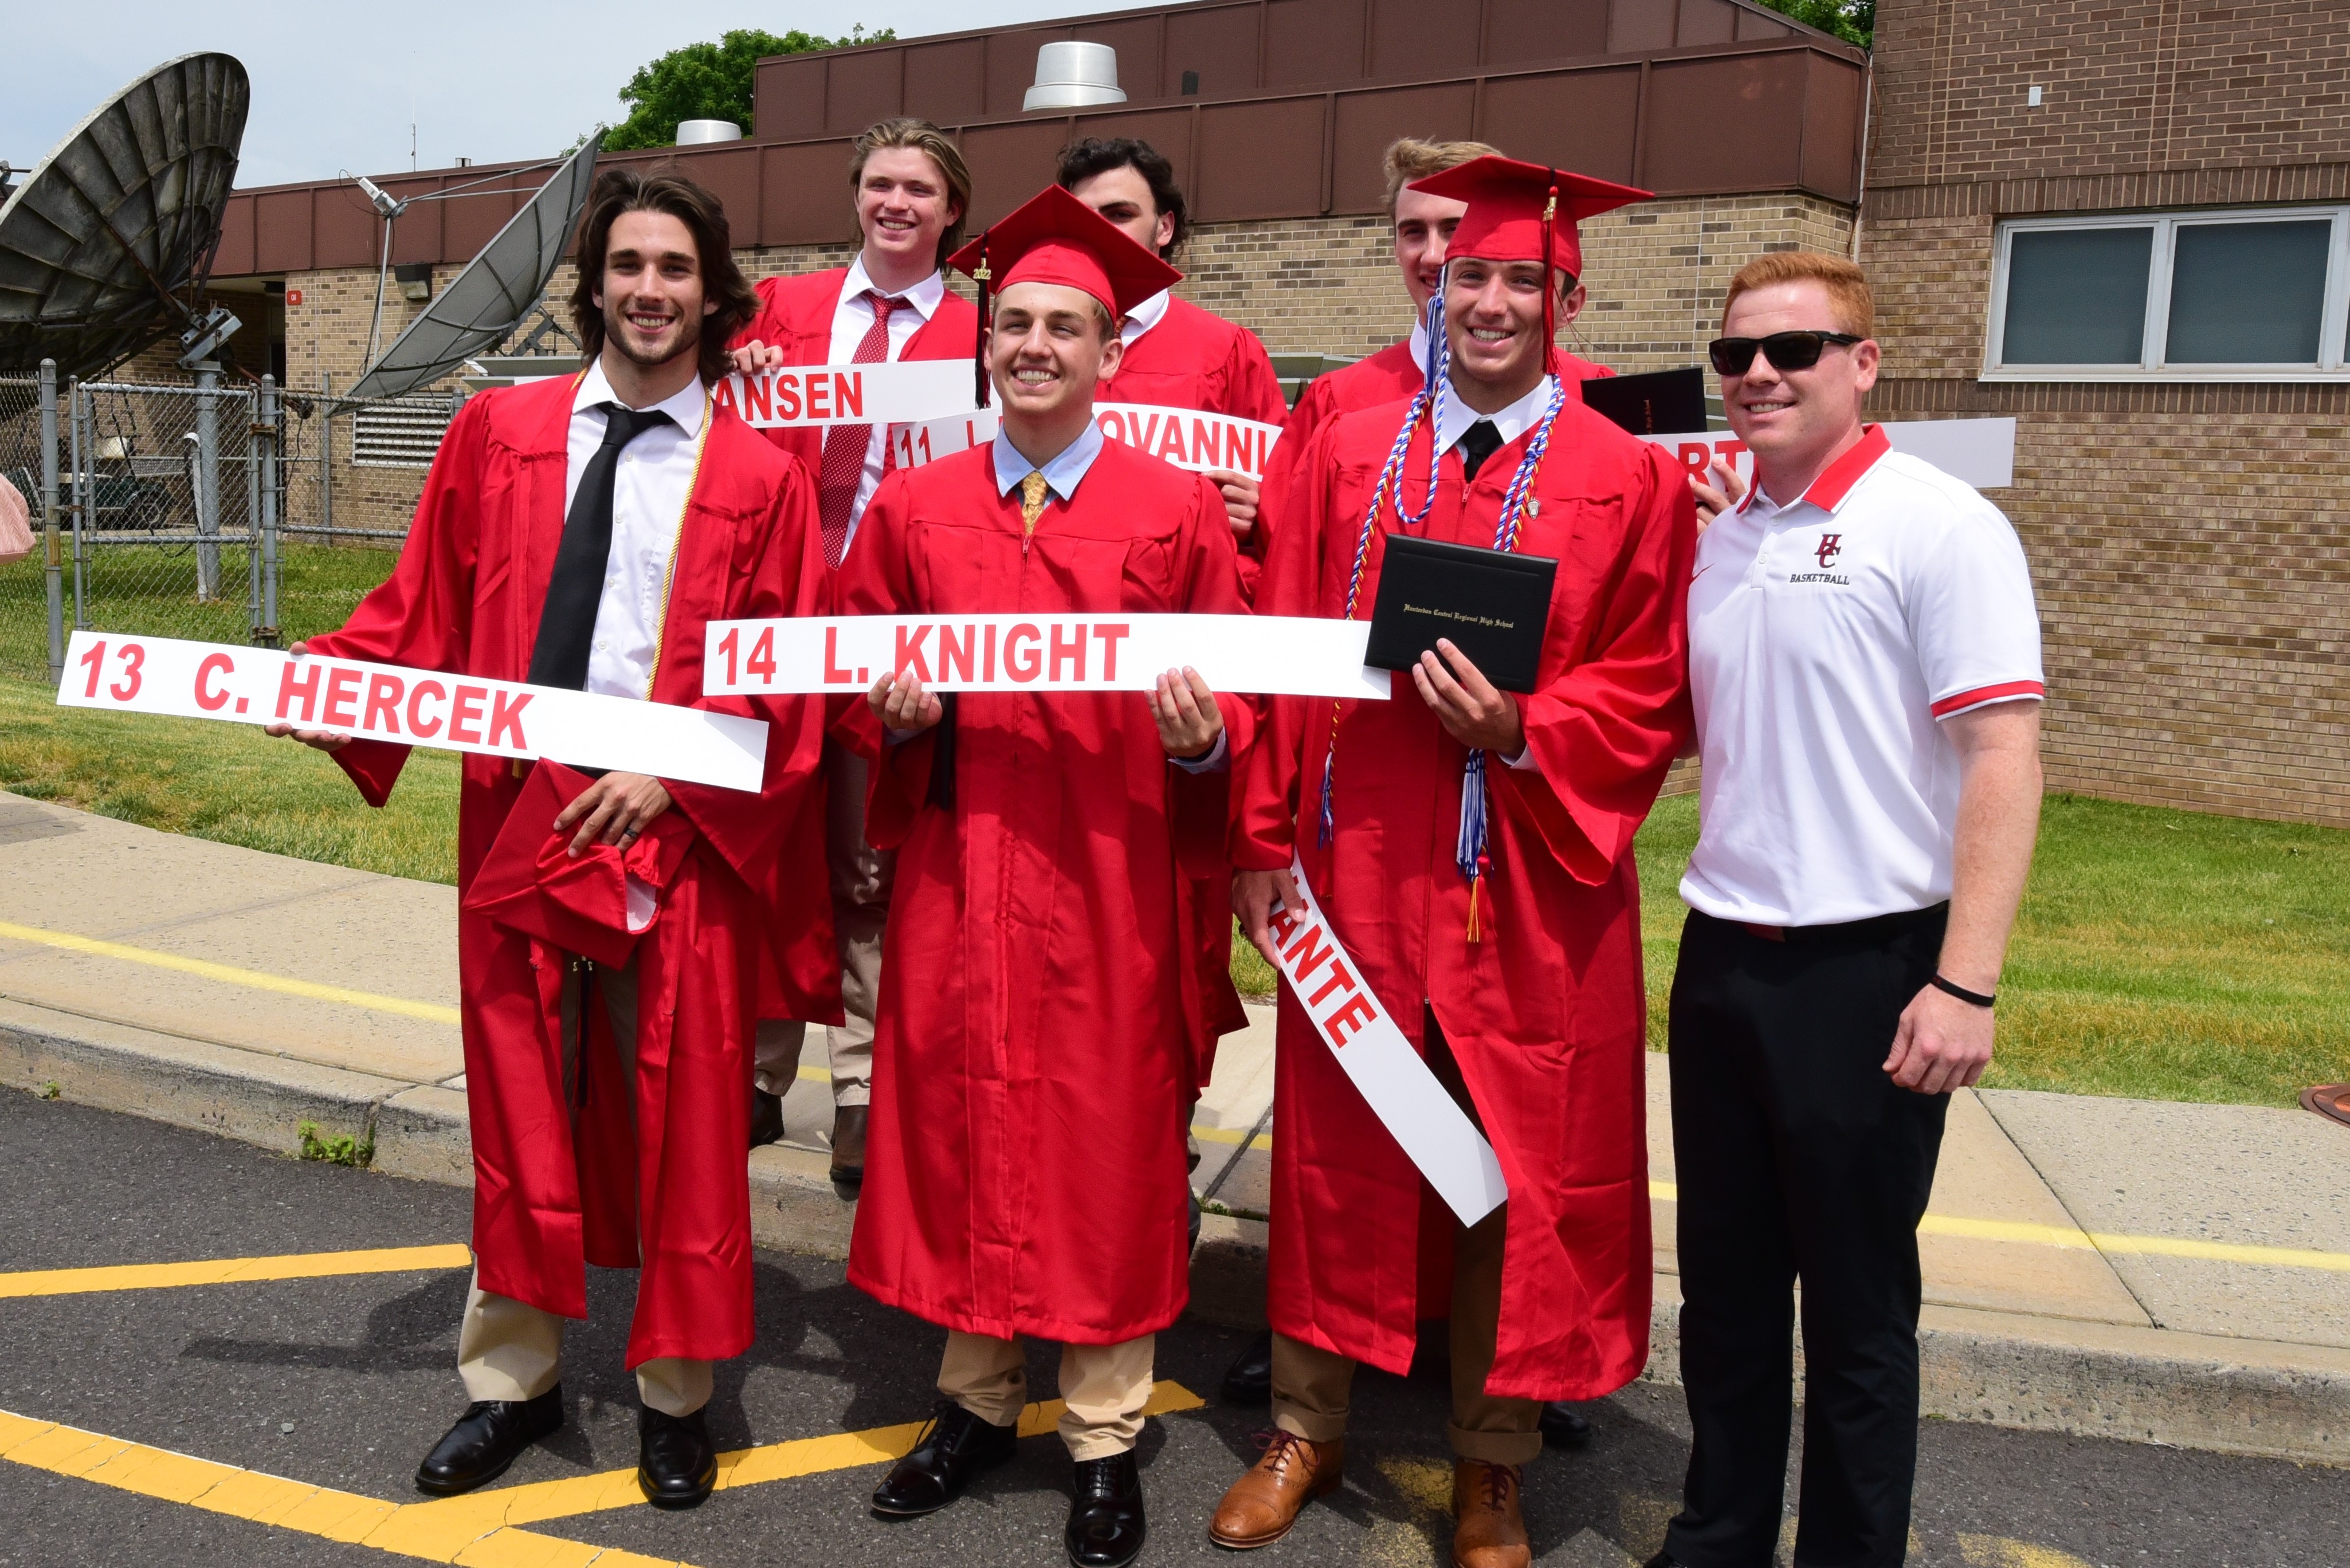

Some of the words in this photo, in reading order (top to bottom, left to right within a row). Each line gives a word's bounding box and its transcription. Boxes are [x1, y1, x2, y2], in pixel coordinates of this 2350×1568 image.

[972, 268, 991, 280] 2022
[900, 426, 932, 468] 11
[1789, 573, 1850, 585] BASKETBALL
[1403, 603, 1432, 615] Hunterdon
[1433, 609, 1453, 618] Central
[1454, 612, 1478, 622] Regional
[1479, 616, 1493, 626] High
[1494, 619, 1514, 628] School
[719, 626, 776, 686] 14
[823, 626, 869, 684] L.
[894, 623, 1130, 683] KNIGHT
[80, 640, 145, 702] 13
[194, 653, 249, 714] C.
[274, 661, 536, 750] HERCEK
[1267, 875, 1378, 1050] ANTE
